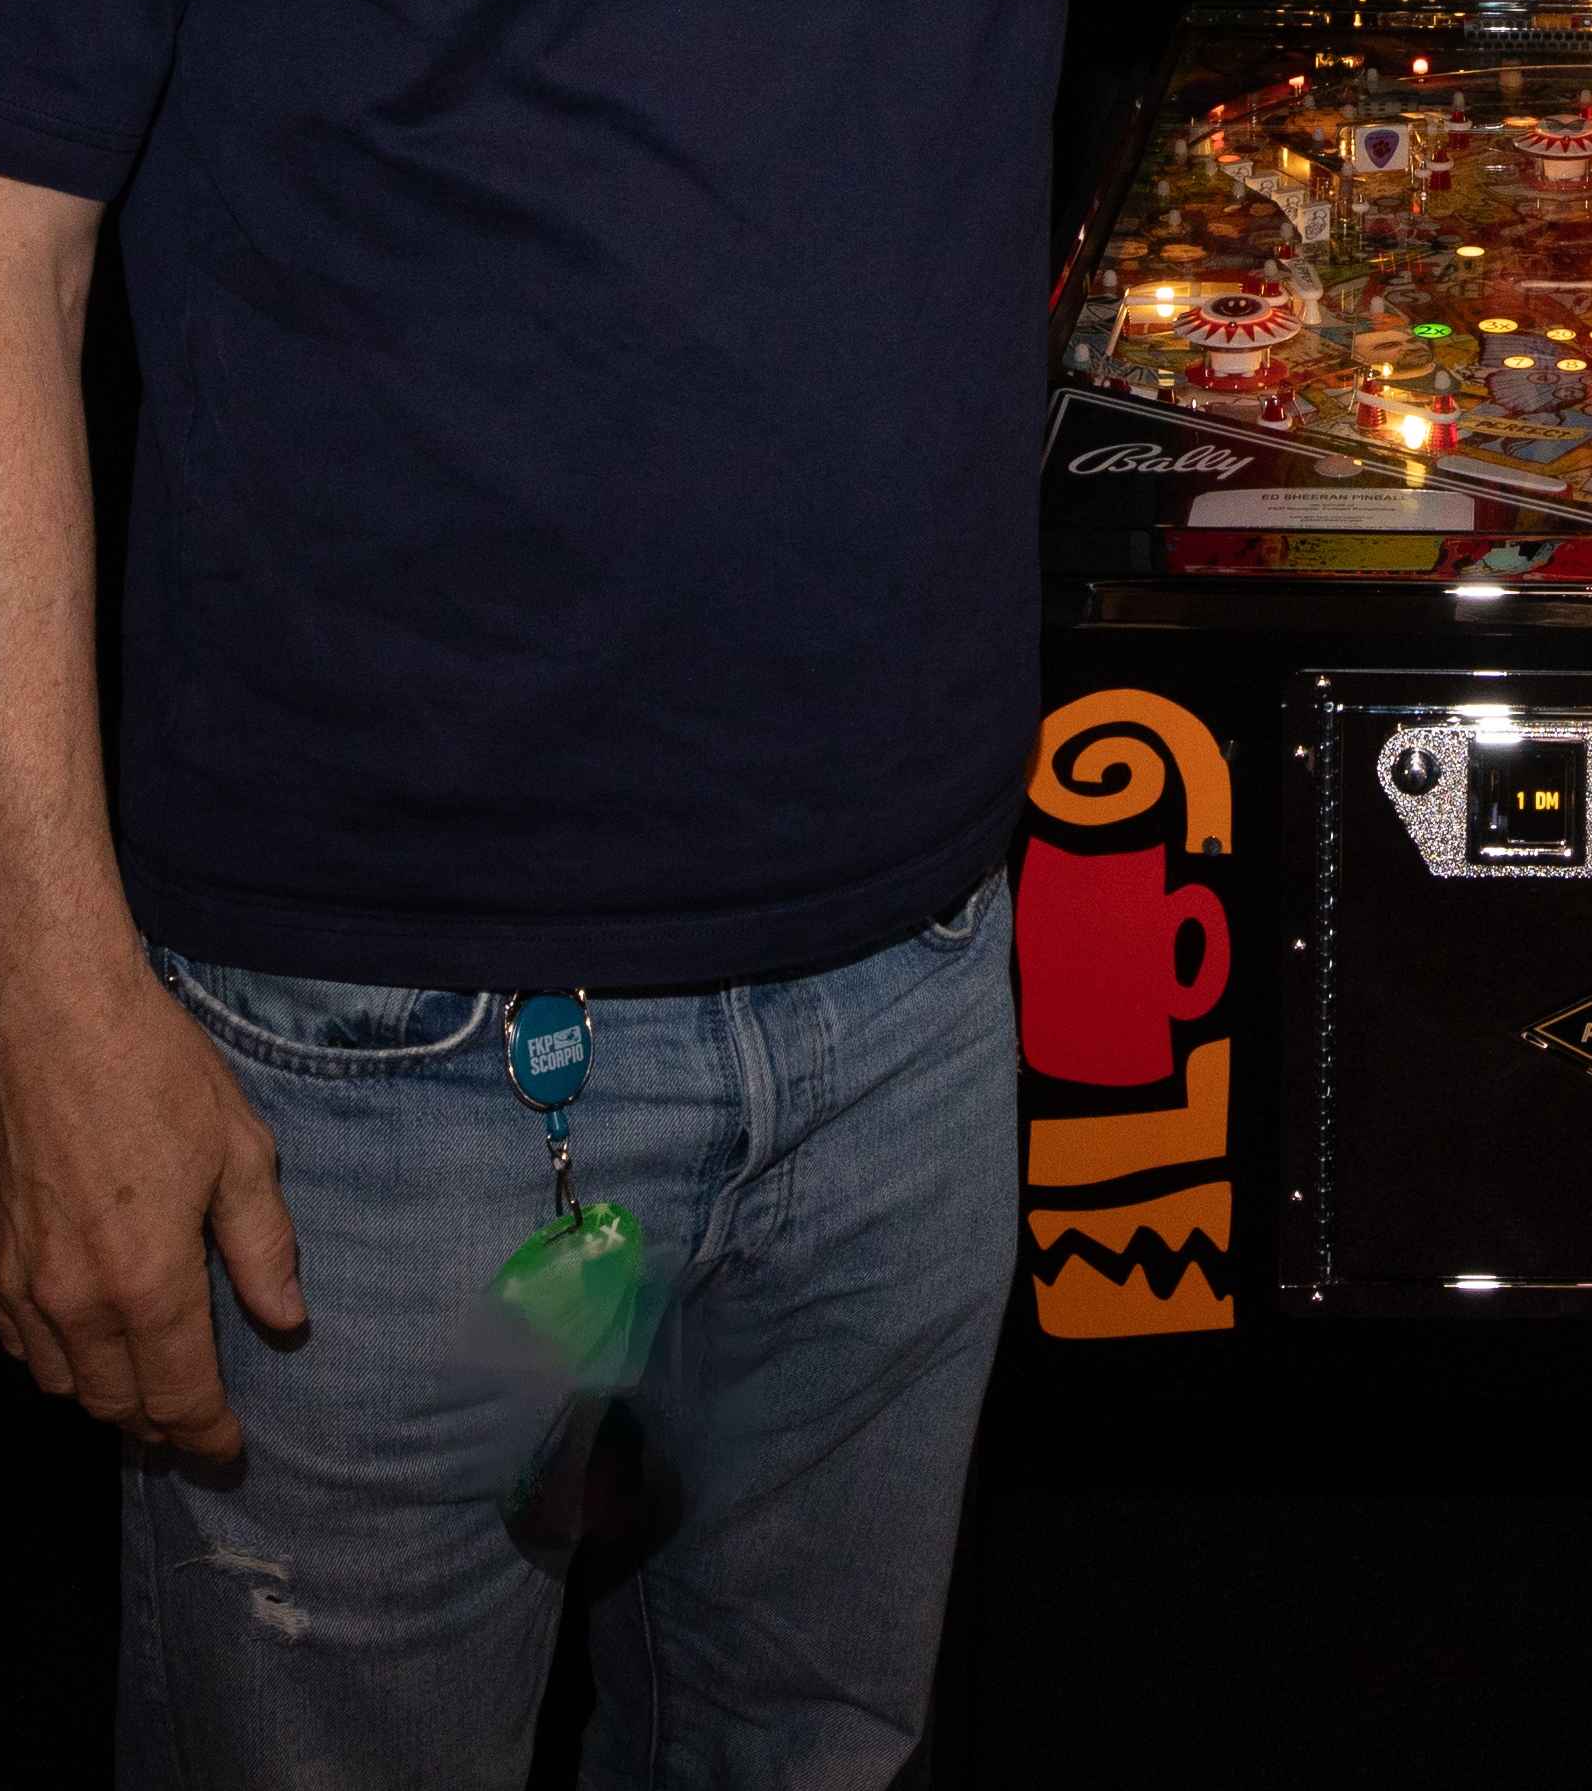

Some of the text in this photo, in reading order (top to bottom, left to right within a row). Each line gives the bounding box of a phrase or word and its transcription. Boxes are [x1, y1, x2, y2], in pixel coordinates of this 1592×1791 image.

[1068, 443, 1255, 480] Bally
[1517, 791, 1559, 810] 1 DM
[528, 1035, 553, 1057] FKP
[530, 1044, 584, 1075] SCORPIO
